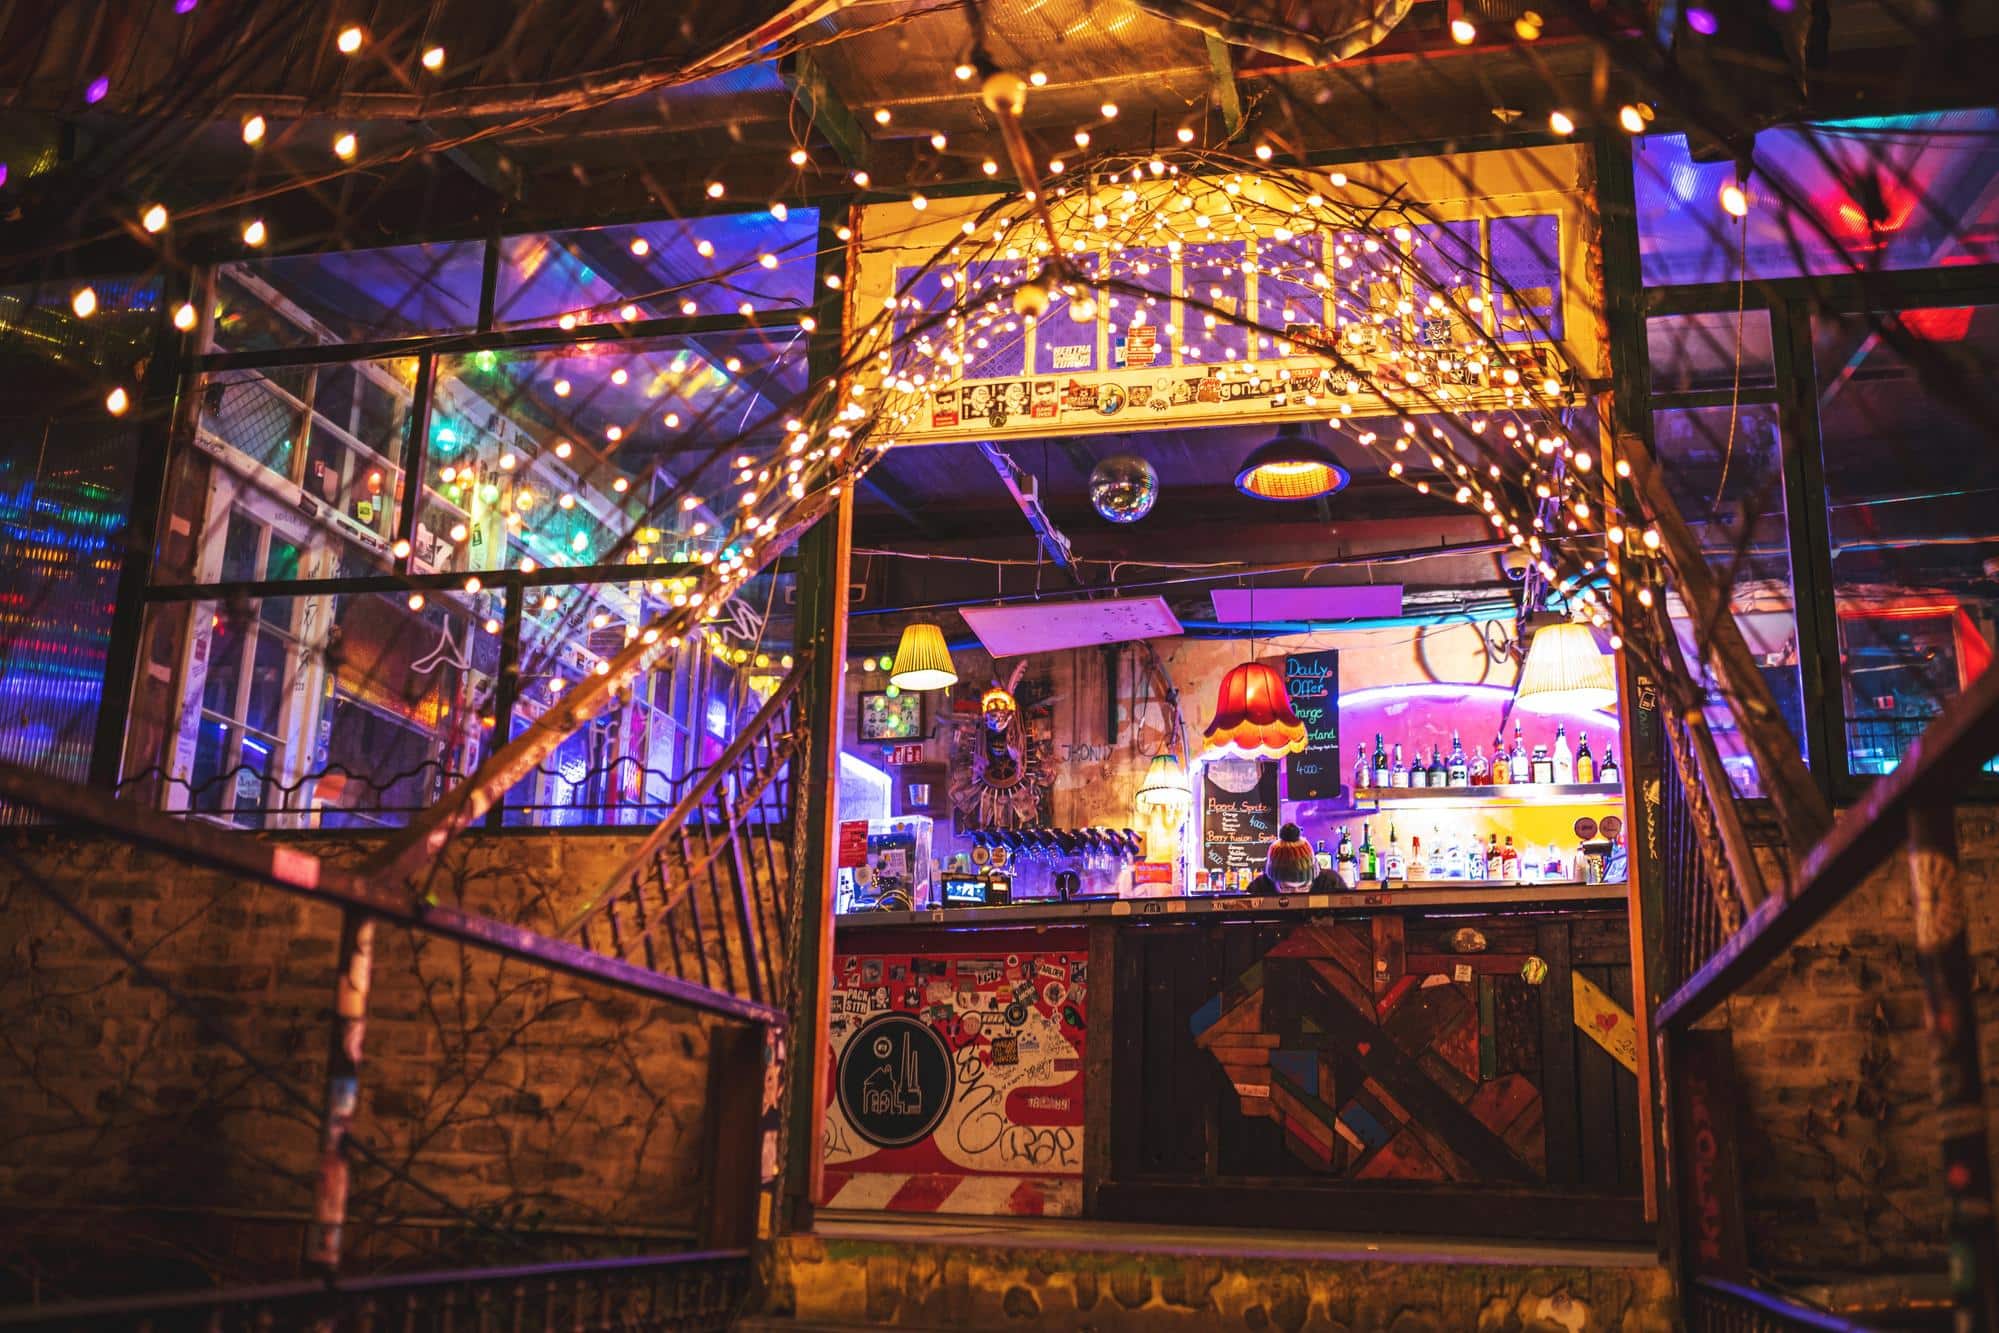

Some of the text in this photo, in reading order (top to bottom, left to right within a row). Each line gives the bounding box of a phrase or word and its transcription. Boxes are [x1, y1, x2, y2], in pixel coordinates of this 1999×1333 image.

[1221, 381, 1270, 399] gonzo
[1287, 658, 1328, 682] Daily
[1291, 680, 1324, 700] Offer
[848, 987, 868, 1002] PACK
